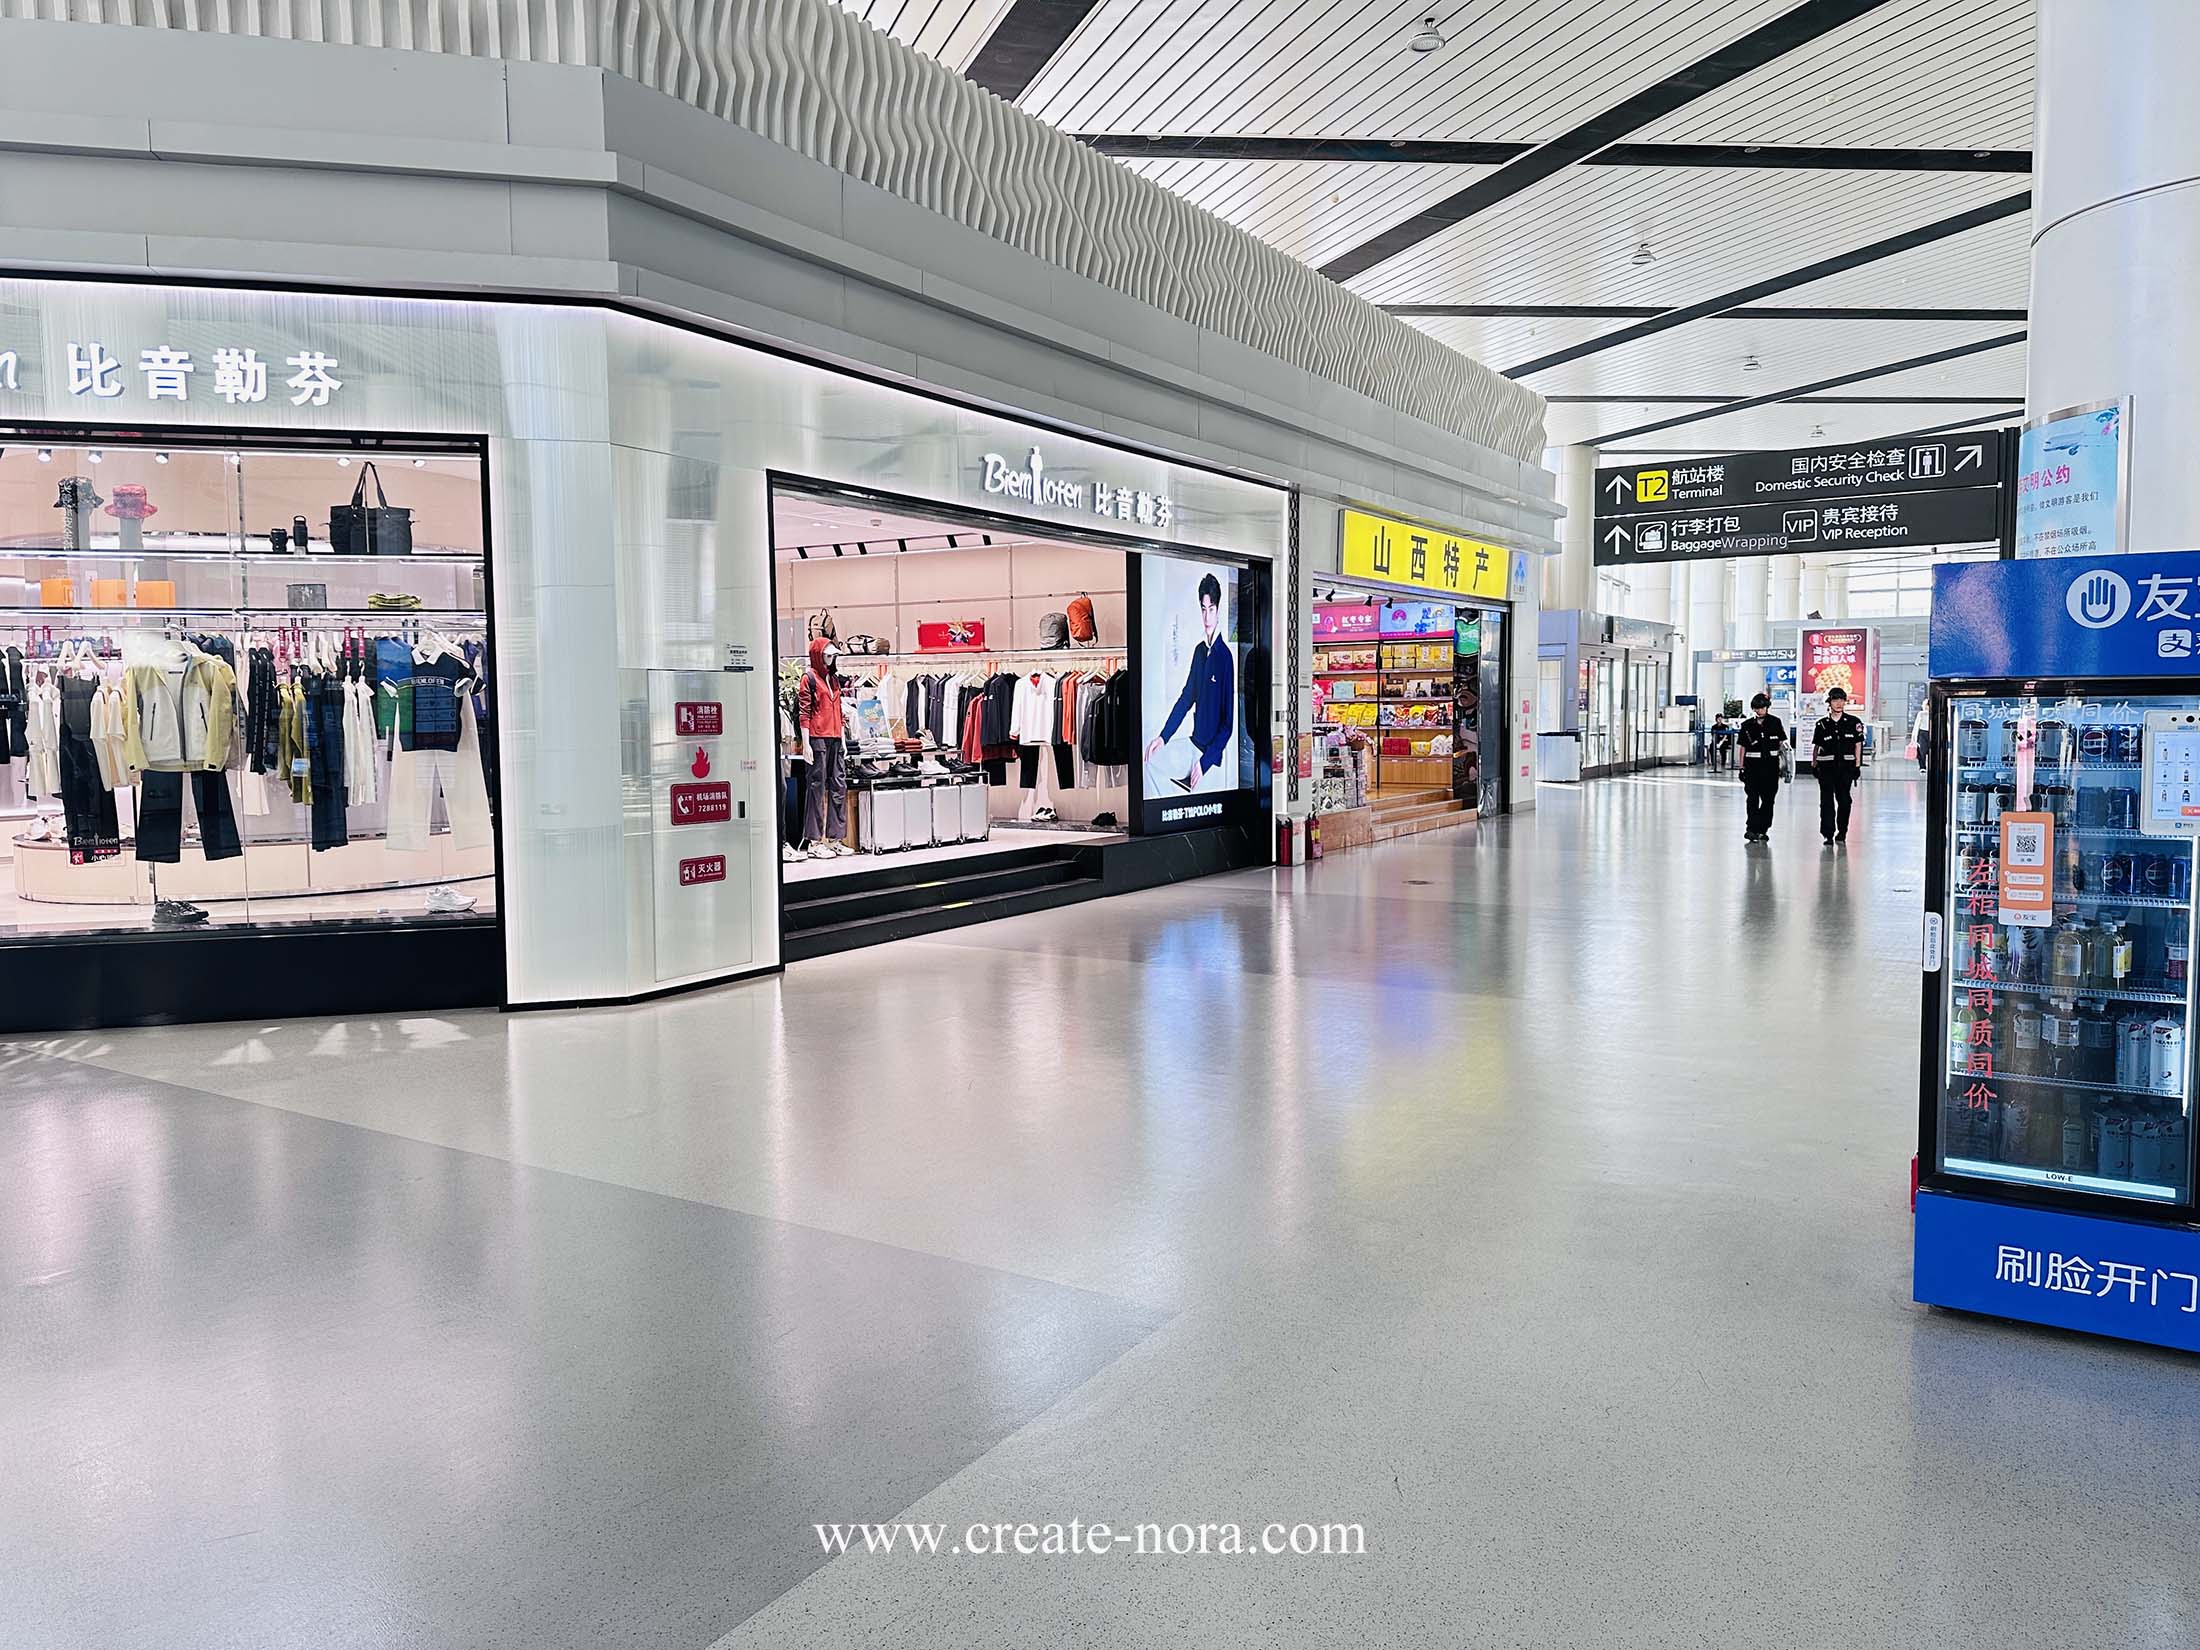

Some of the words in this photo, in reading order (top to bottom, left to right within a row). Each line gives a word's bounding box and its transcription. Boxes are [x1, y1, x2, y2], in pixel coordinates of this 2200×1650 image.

[67, 342, 343, 406] 比音勒芬
[1791, 448, 1905, 475] 国内安全检查
[1671, 465, 1724, 486] 航站楼
[1755, 477, 1811, 492] Domestic
[1814, 472, 1863, 490] Security
[1866, 469, 1904, 484] Check
[1639, 477, 1666, 499] T2
[1672, 485, 1722, 500] Terminal
[1093, 482, 1174, 528] 比音勒芬
[1822, 504, 1898, 526] 贵宾接待
[1671, 516, 1741, 536] 行李打包
[1786, 518, 1814, 534] VIP
[1822, 527, 1842, 540] VIP
[1845, 523, 1908, 540] Reception
[1373, 525, 1489, 590] 山西特产
[2135, 574, 2200, 622] 友
[698, 804, 727, 813] 7288119
[697, 861, 721, 874] 灭火器
[1965, 857, 1998, 1112] 左柜同城同质同价
[2046, 1173, 2073, 1182] LOW-E
[1996, 1245, 2199, 1313] 刷脸开门
